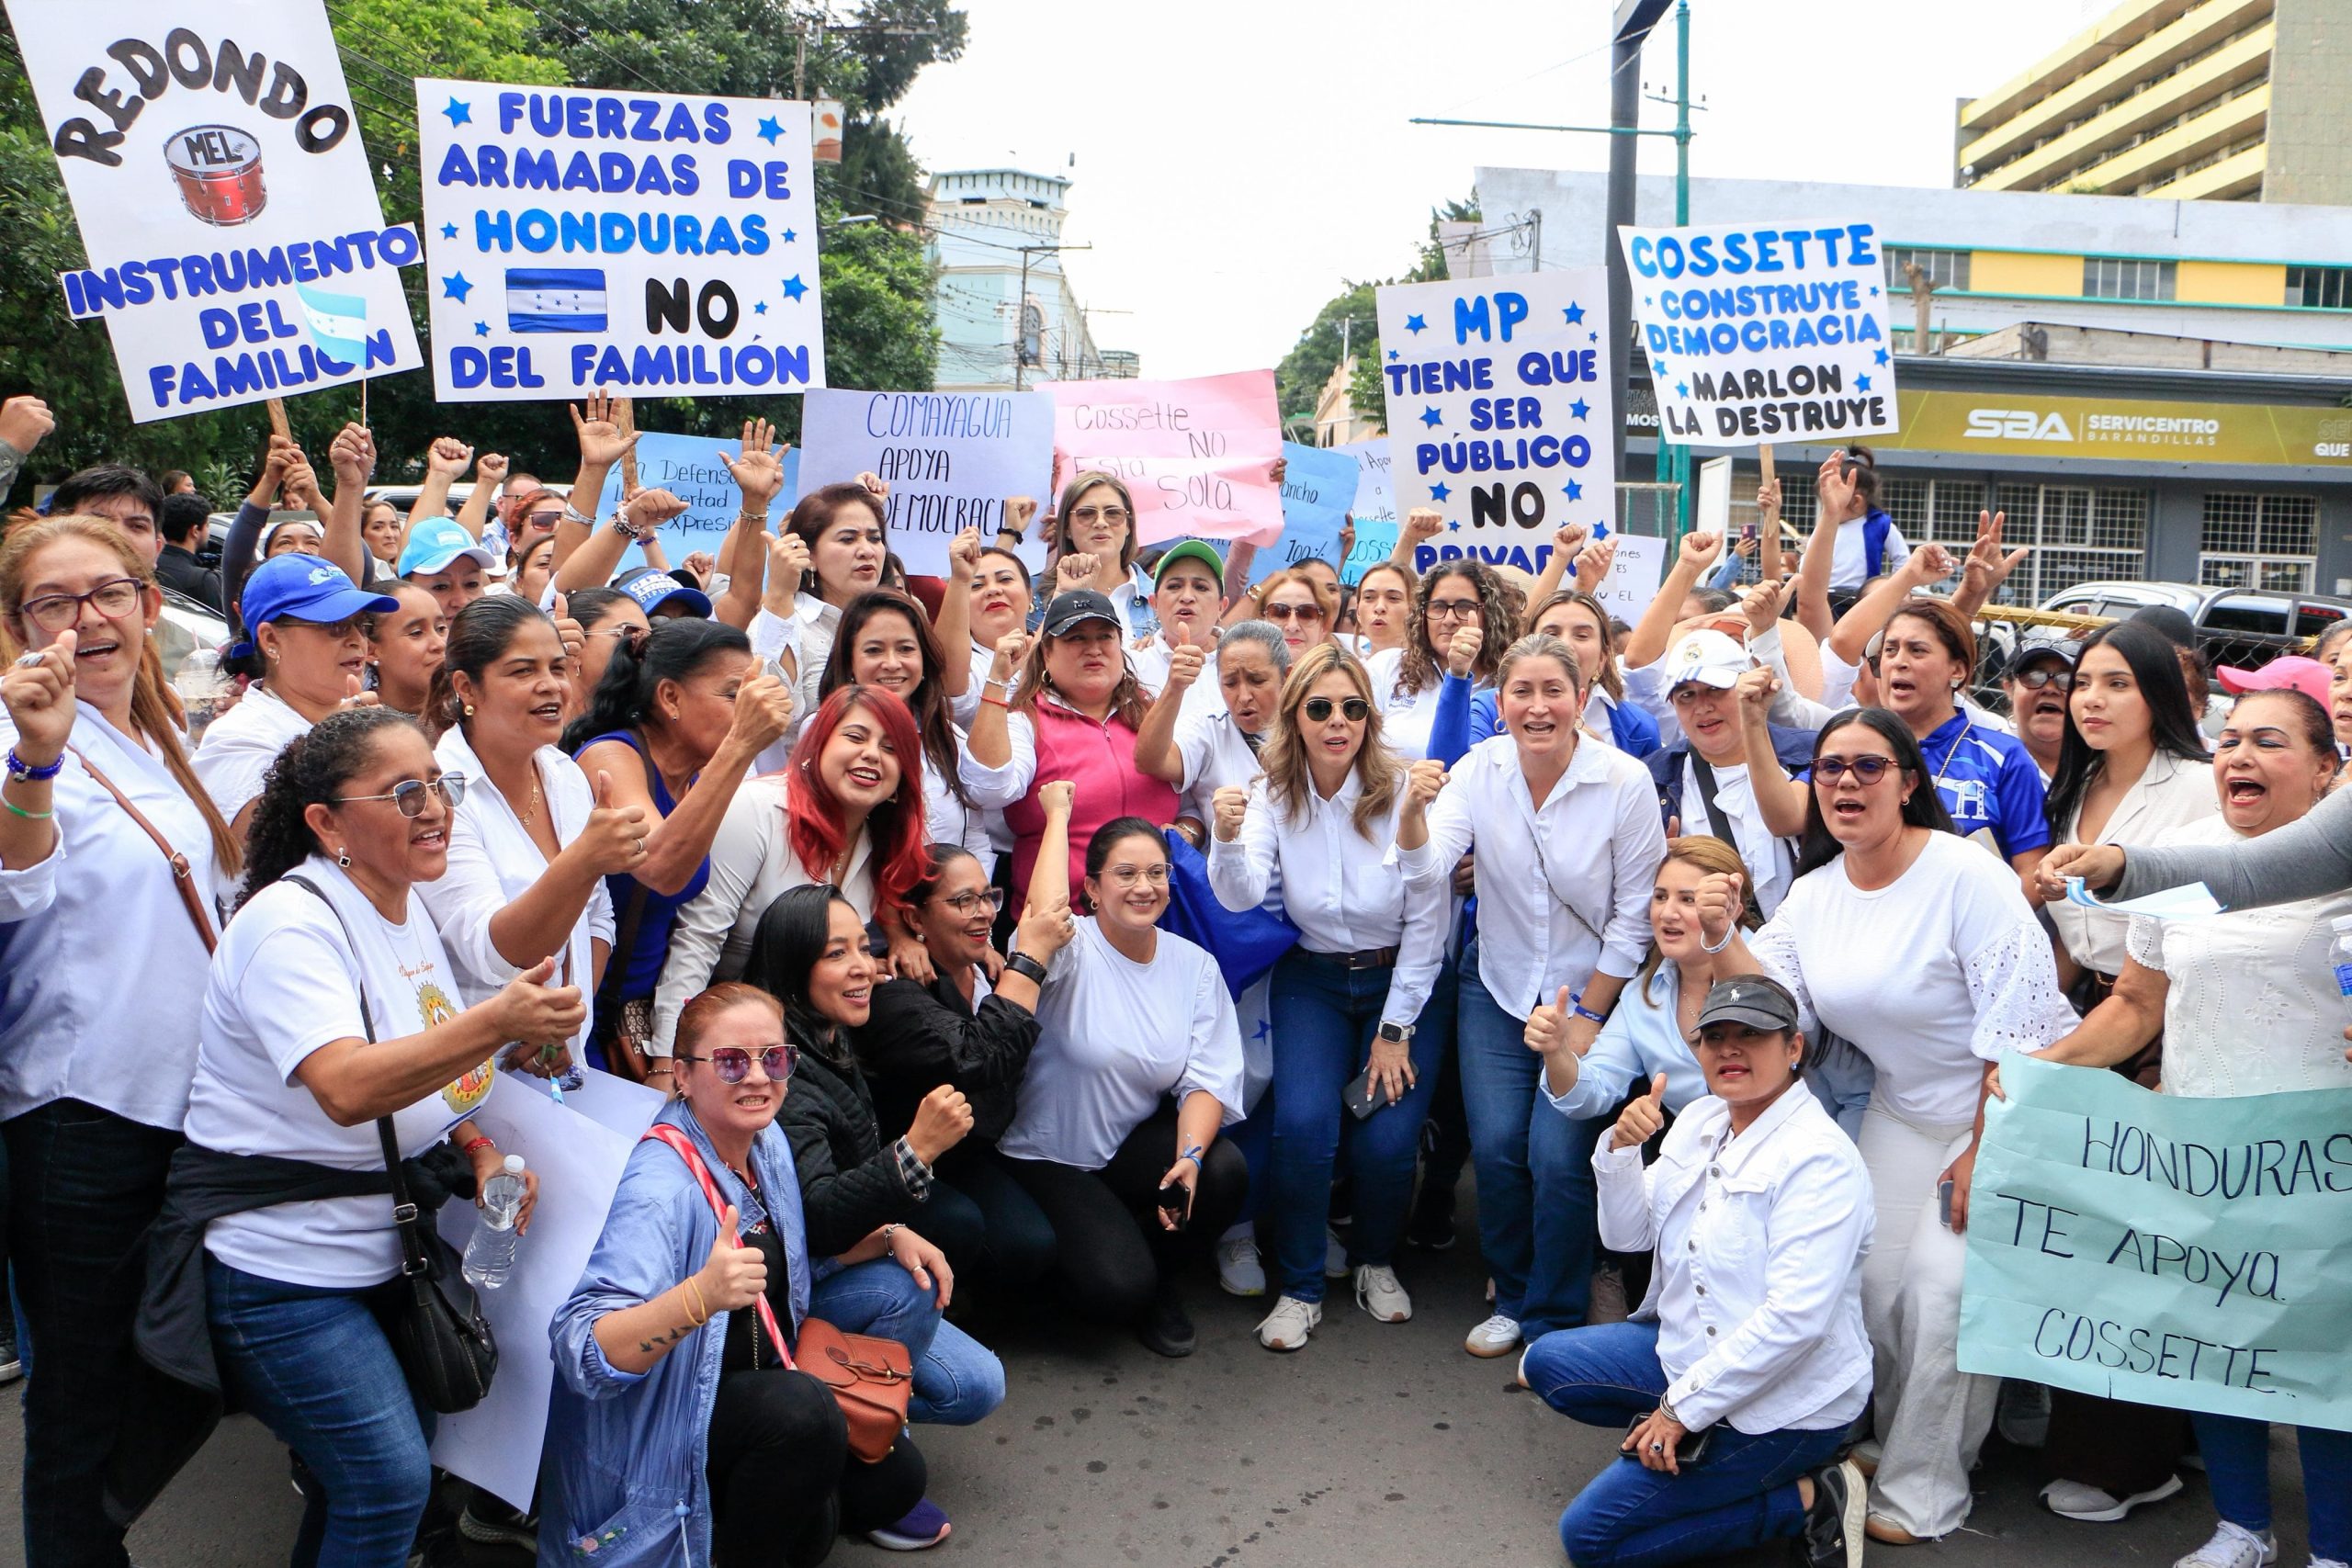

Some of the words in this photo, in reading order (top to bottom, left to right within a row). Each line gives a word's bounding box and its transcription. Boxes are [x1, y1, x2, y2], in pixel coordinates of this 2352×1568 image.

[54, 28, 349, 167] REDONDO
[498, 92, 731, 144] FUERZAS
[184, 131, 243, 165] MEL
[438, 144, 699, 196] ARMADAS
[728, 159, 791, 200] DE
[475, 209, 770, 255] HONDURAS
[1631, 224, 1876, 280] COSSETTE
[65, 227, 419, 315] INSTRUMENTO
[645, 277, 739, 340] NO
[1454, 292, 1528, 345] MP
[1660, 280, 1860, 321] CONSTRUYE
[199, 299, 298, 349] DEL
[1646, 313, 1882, 356] DEMOCRACIA
[450, 345, 545, 389] DEL
[571, 334, 809, 386] FAMILIÓN
[1385, 357, 1493, 396] TIENE
[1517, 349, 1597, 386] QUE
[1692, 365, 1842, 401] MARLON
[867, 392, 1011, 438] COMAYAGUA
[1074, 401, 1190, 432] Cossette
[1469, 397, 1543, 432] SER
[1667, 405, 1703, 436] LA
[1715, 396, 1886, 437] DESTRUYE
[1962, 409, 2075, 442] SBA
[2087, 414, 2219, 434] SERVICENTRO
[1188, 431, 1226, 459] NO
[1416, 433, 1591, 475] PÚBLICO
[2087, 432, 2216, 446] BARANDILLAS
[2314, 443, 2350, 457] QUE
[879, 446, 950, 482] APOYA
[1470, 480, 1545, 529] NO
[2082, 1116, 2352, 1201] HONDURAS
[1996, 1192, 2079, 1258] TE
